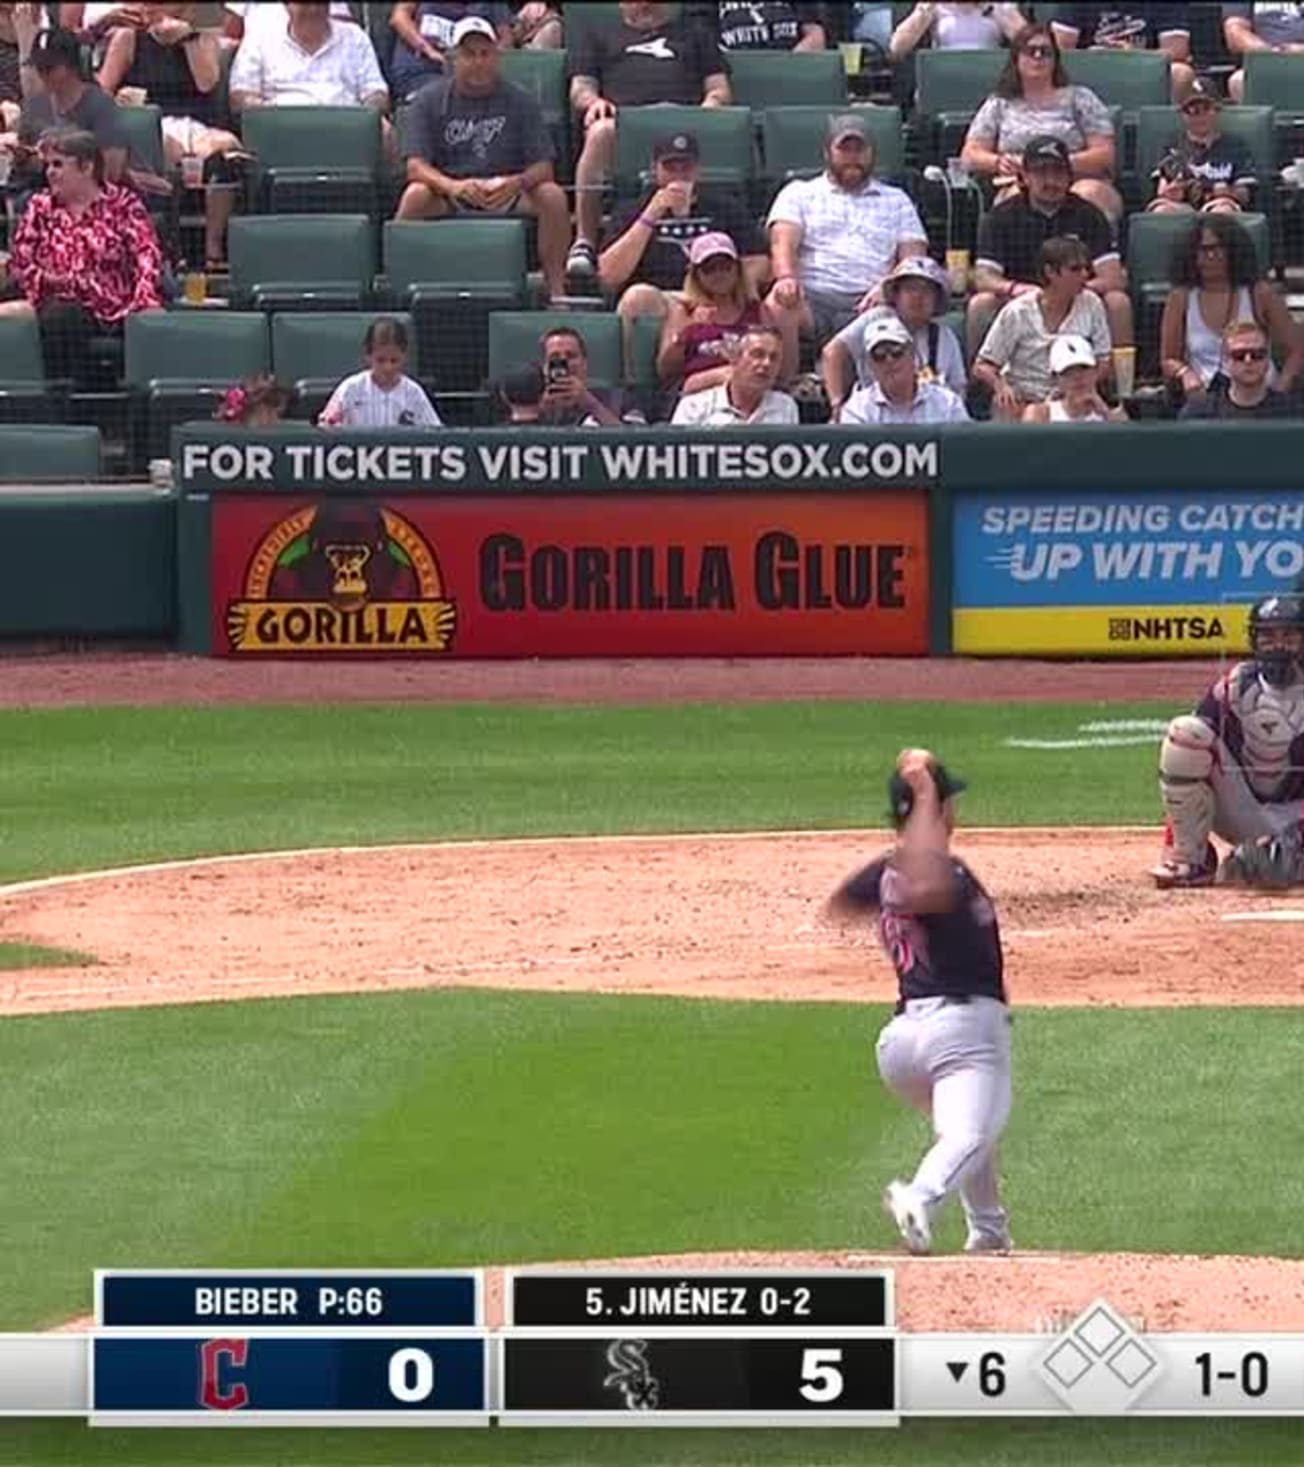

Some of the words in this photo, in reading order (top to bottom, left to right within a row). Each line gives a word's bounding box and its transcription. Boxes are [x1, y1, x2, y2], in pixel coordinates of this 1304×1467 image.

[184, 444, 273, 479] FOR
[285, 444, 466, 480] TICKETS
[478, 444, 589, 480] VISIT
[600, 442, 938, 479] WHITESOX.COM
[982, 505, 1169, 534] SPEEDING
[479, 531, 737, 611] GORILLA
[754, 530, 906, 610] GLUE
[1008, 544, 1083, 581] UP
[1092, 542, 1224, 580] WITH
[255, 606, 431, 644] GORILLA
[1134, 616, 1224, 641] NHTSA
